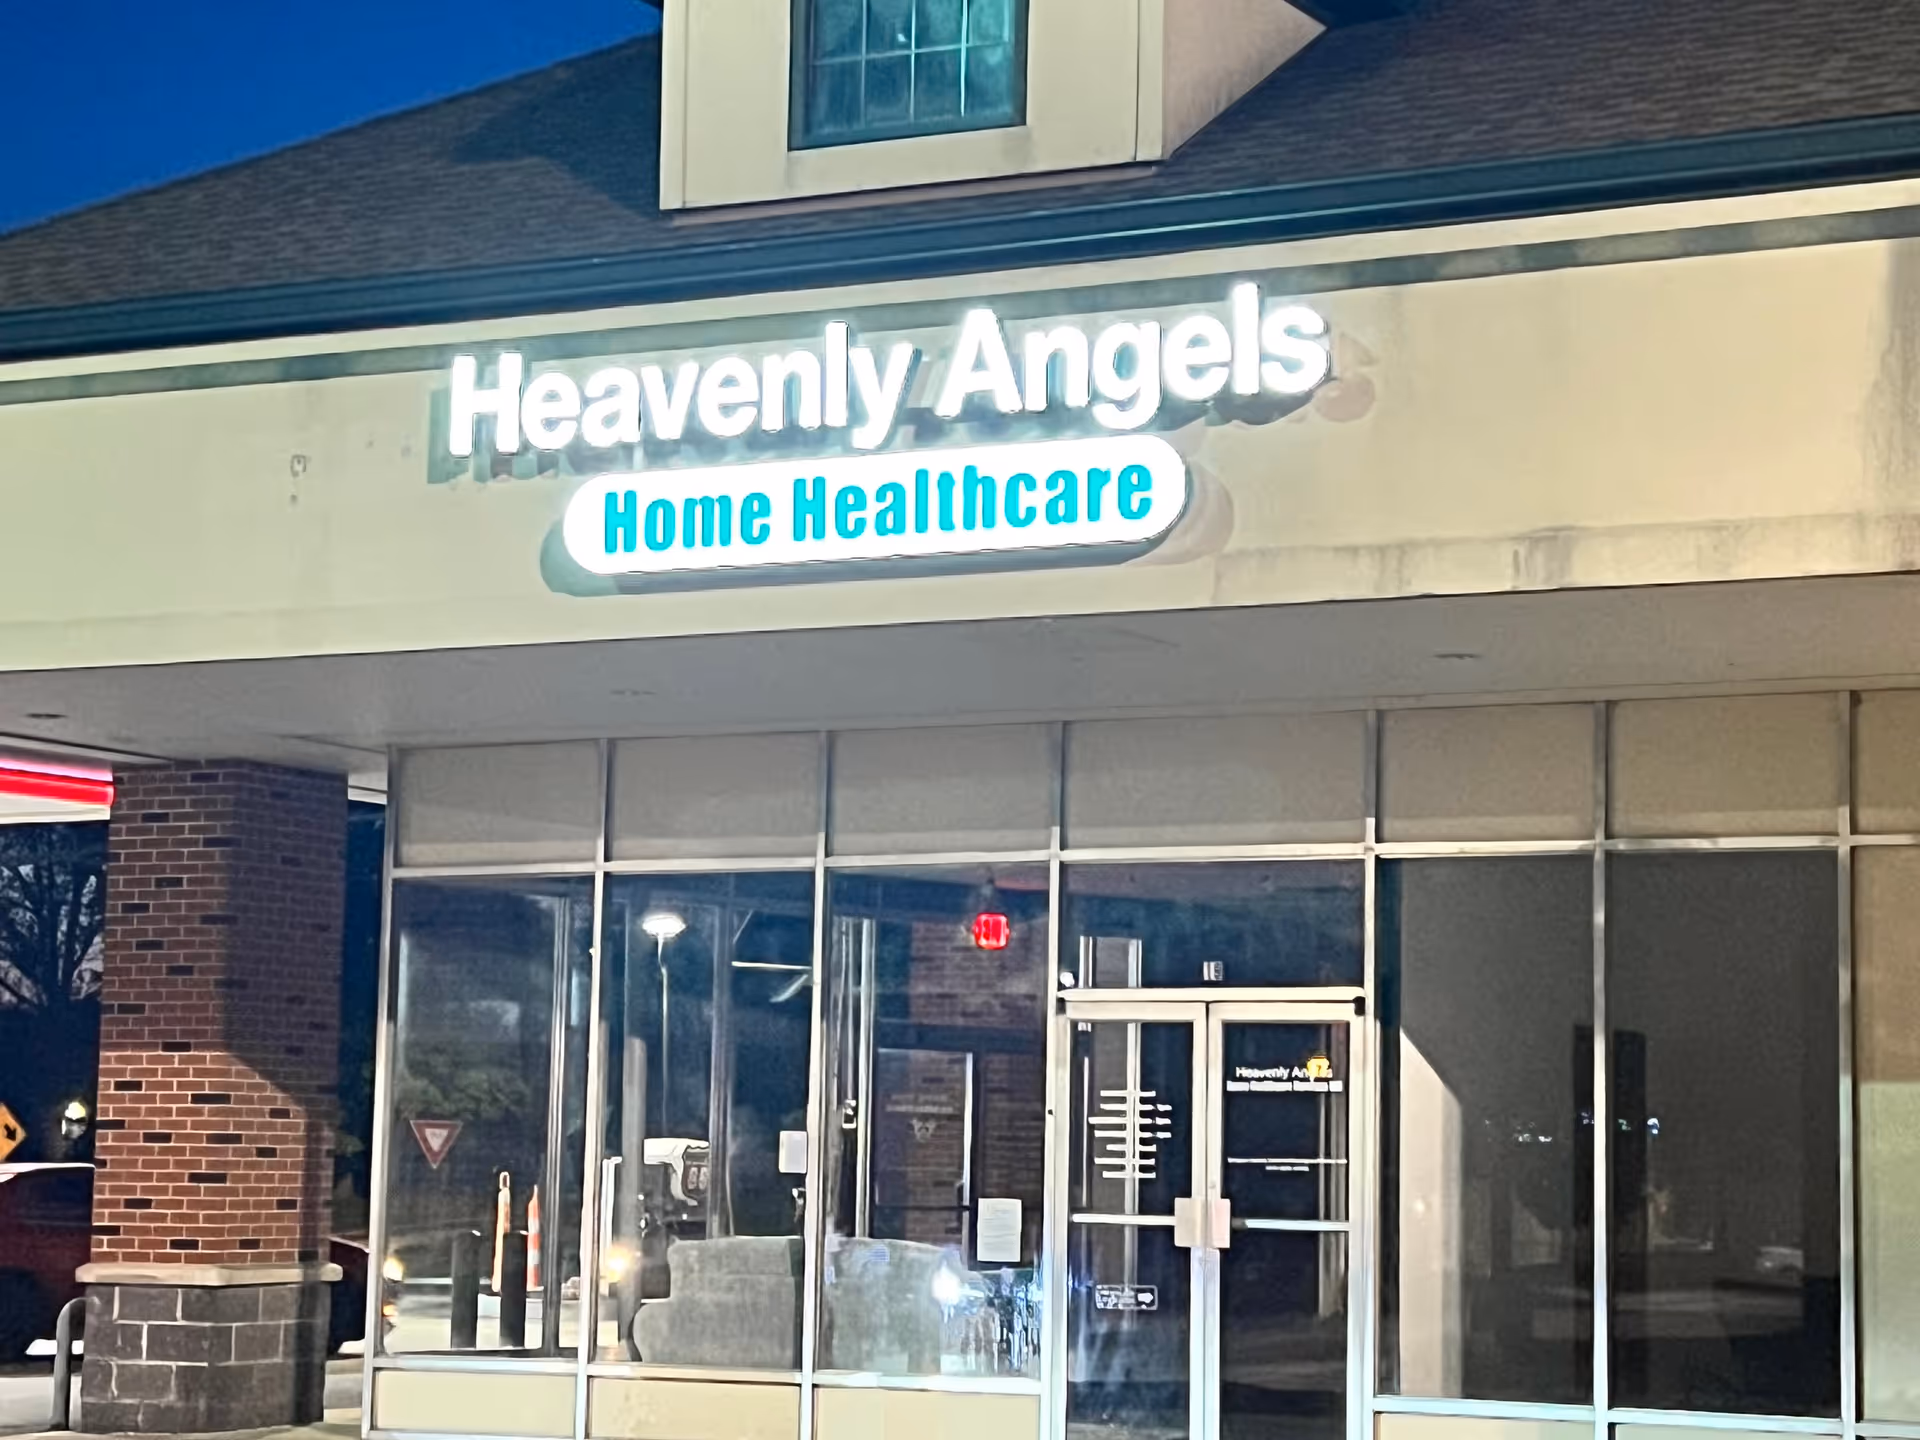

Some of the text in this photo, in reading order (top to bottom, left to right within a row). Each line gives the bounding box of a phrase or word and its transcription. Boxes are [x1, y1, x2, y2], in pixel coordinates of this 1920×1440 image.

[449, 282, 1329, 457] Heavenly Angels
[604, 464, 1153, 554] Home Healthcare
